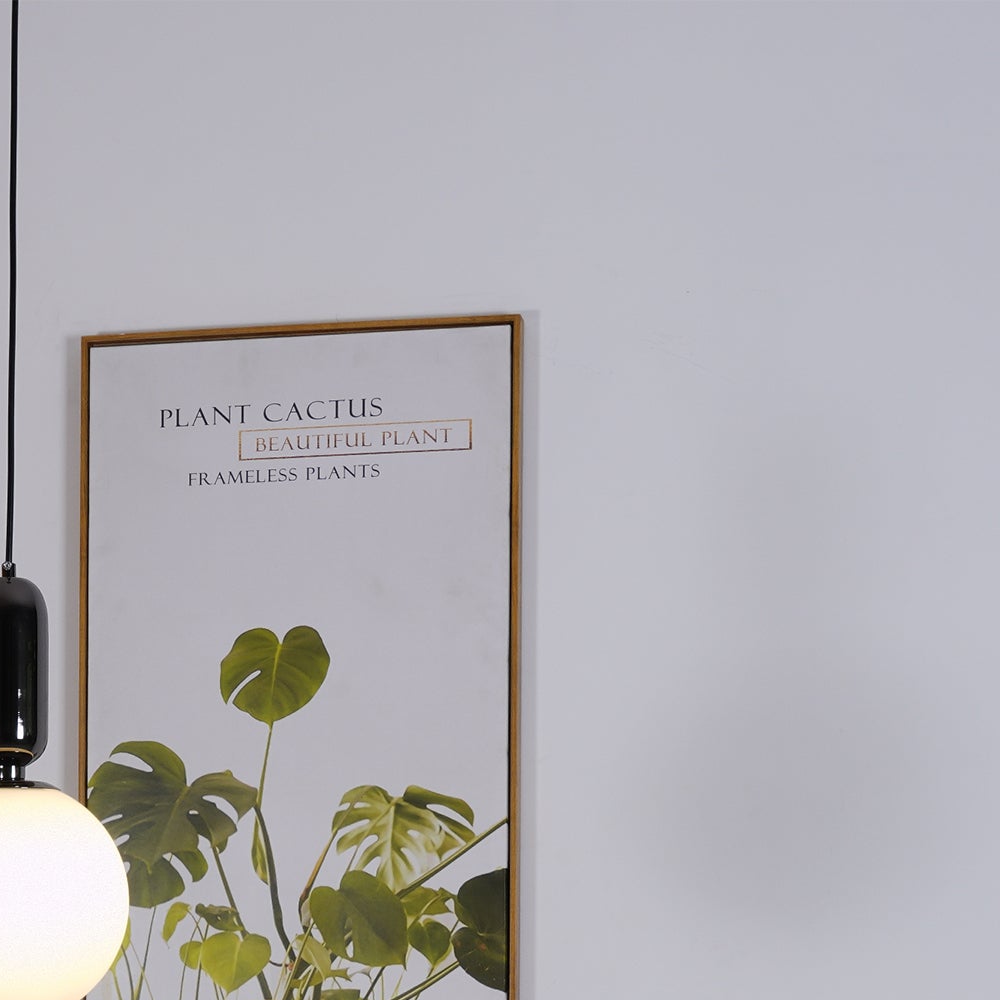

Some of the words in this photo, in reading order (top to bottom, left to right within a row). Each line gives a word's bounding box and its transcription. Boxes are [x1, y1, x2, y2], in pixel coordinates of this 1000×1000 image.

[160, 404, 251, 428] PLANT
[263, 397, 383, 423] CACTUS
[256, 430, 372, 452] BEAUTIFUL
[382, 428, 453, 446] PLANT
[188, 467, 297, 486] FRAMELESS
[306, 464, 381, 481] PLANTS
